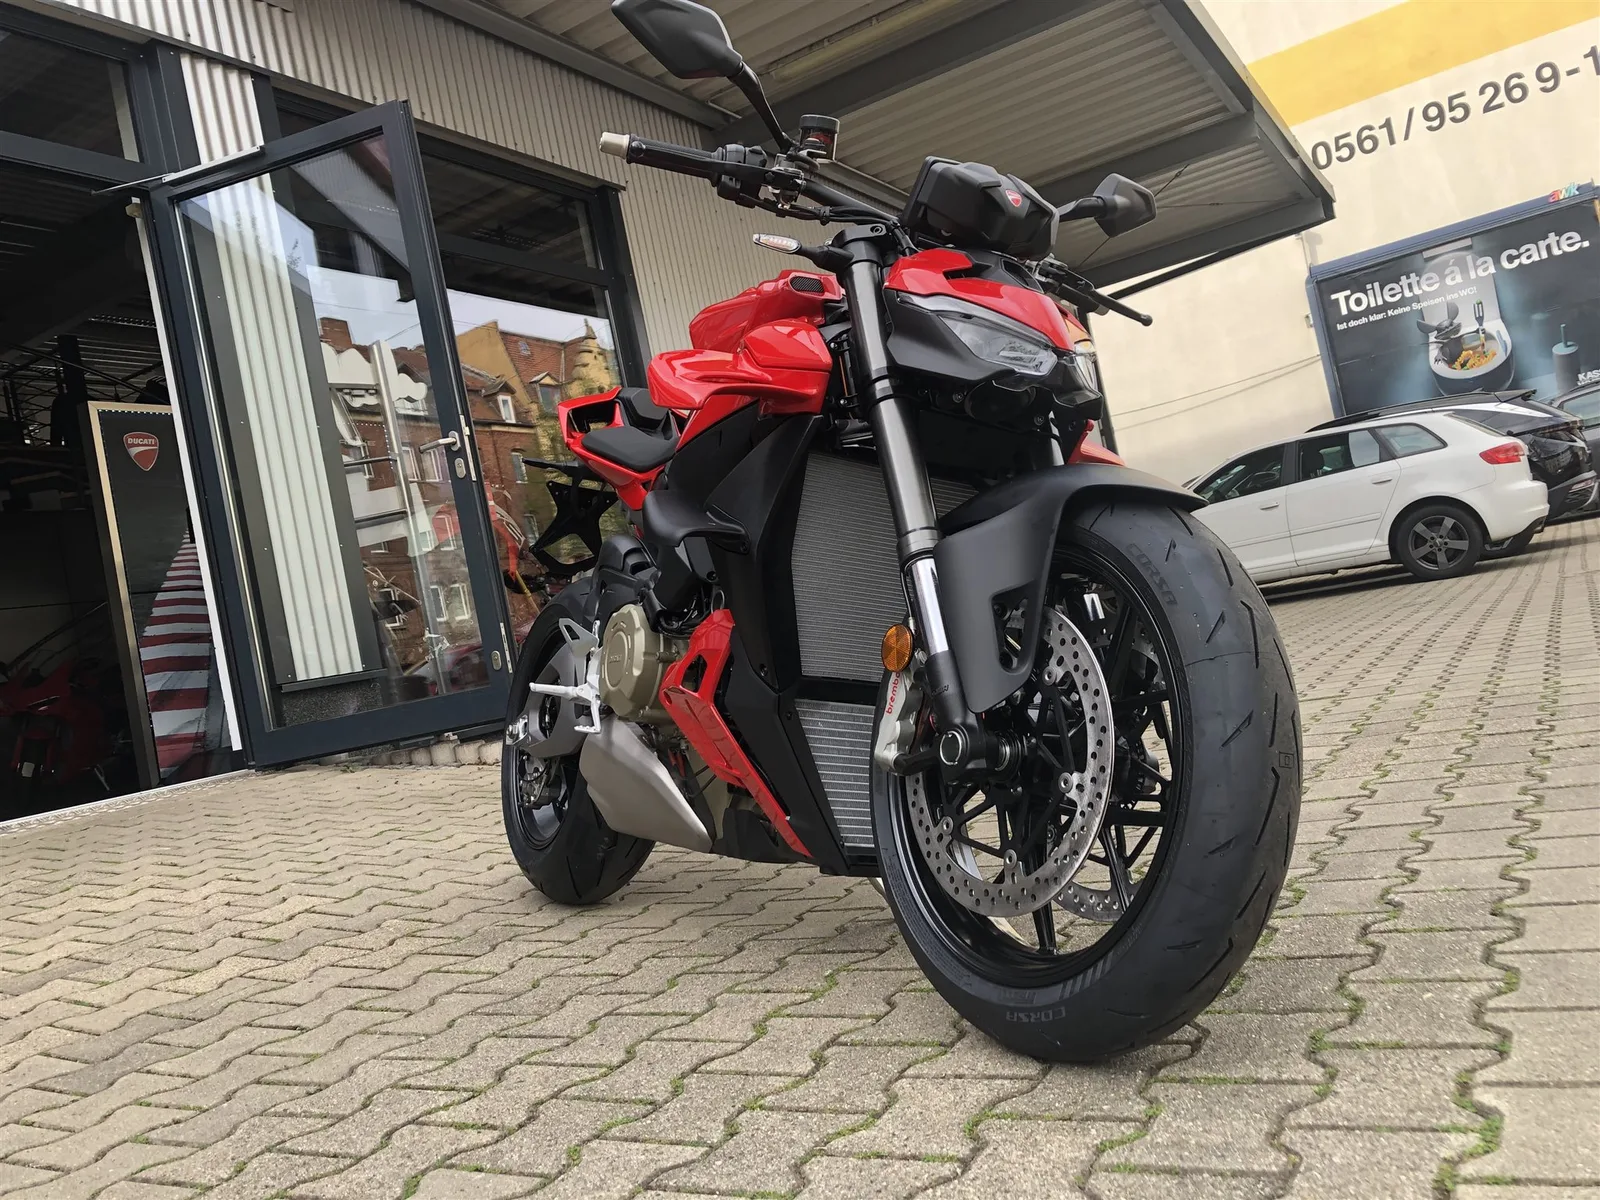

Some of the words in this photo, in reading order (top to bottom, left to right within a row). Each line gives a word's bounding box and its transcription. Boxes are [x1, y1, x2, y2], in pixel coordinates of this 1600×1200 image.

[1330, 271, 1441, 316] Toilette
[1444, 258, 1463, 286] á
[1466, 255, 1497, 280] la
[1499, 230, 1591, 270] carte.
[1336, 321, 1348, 331] Ist
[1347, 315, 1369, 329] doch
[1369, 311, 1387, 323] klar:
[1387, 304, 1412, 318] Keine
[1411, 295, 1446, 312] Speisen
[1458, 286, 1478, 300] WC!
[1577, 369, 1600, 381] KAS
[127, 437, 156, 445] DUCATI
[1125, 543, 1178, 606] CORSA
[1005, 1005, 1067, 1023] CORSA
